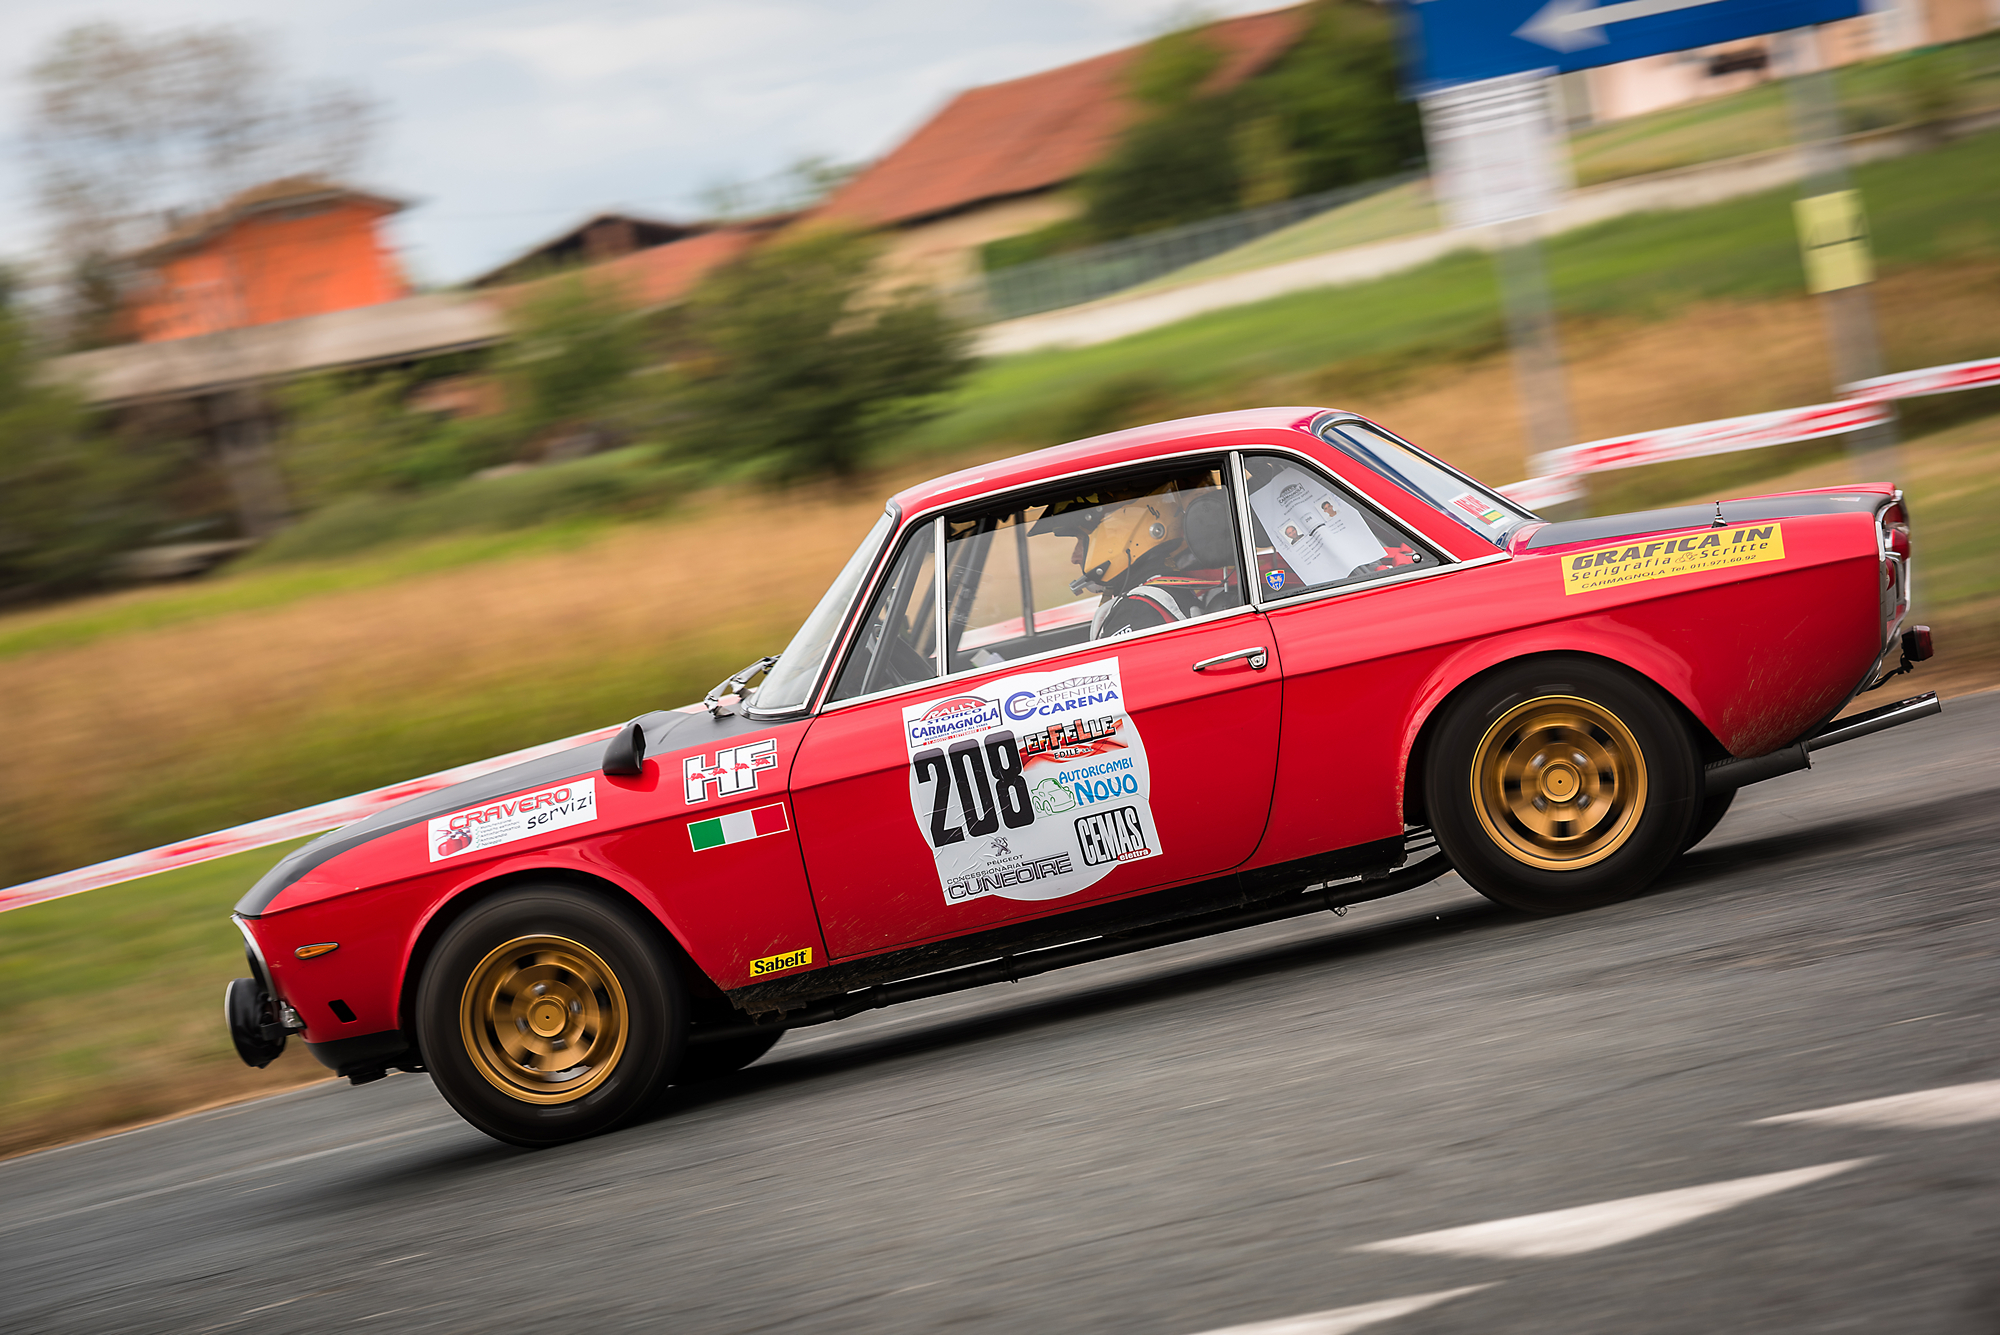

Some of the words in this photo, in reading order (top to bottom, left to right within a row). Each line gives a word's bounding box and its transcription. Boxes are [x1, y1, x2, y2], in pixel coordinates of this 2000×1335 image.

[1570, 555, 1671, 582] Serigrafia
[1700, 541, 1769, 559] Scritte
[1571, 534, 1721, 571] GRAFICA
[1732, 526, 1774, 544] IN
[1581, 569, 1666, 589] CARMAGNOLA
[1026, 681, 1118, 708] CARPENTERIA
[1038, 690, 1119, 716] CARENA
[912, 707, 999, 739] CARMAGNOLA
[926, 700, 979, 720] RALLY
[927, 708, 982, 725] STORICO
[1023, 715, 1117, 756] EFFELLE
[1054, 747, 1080, 760] EDILE
[683, 738, 777, 804] HF
[1058, 757, 1134, 785] AUTORICAMBI
[912, 730, 1035, 848] 208
[1074, 773, 1138, 806] NOVO
[449, 788, 573, 831] CRAVERO
[527, 791, 593, 830] servizi
[1077, 808, 1145, 865] CEMAS
[986, 854, 1024, 867] PEUGEOT
[1119, 849, 1149, 861] elettra
[946, 862, 1022, 885] CONCESSIONARIA
[949, 852, 1073, 900] CUNEOTRE
[754, 950, 807, 976] Sabelt
